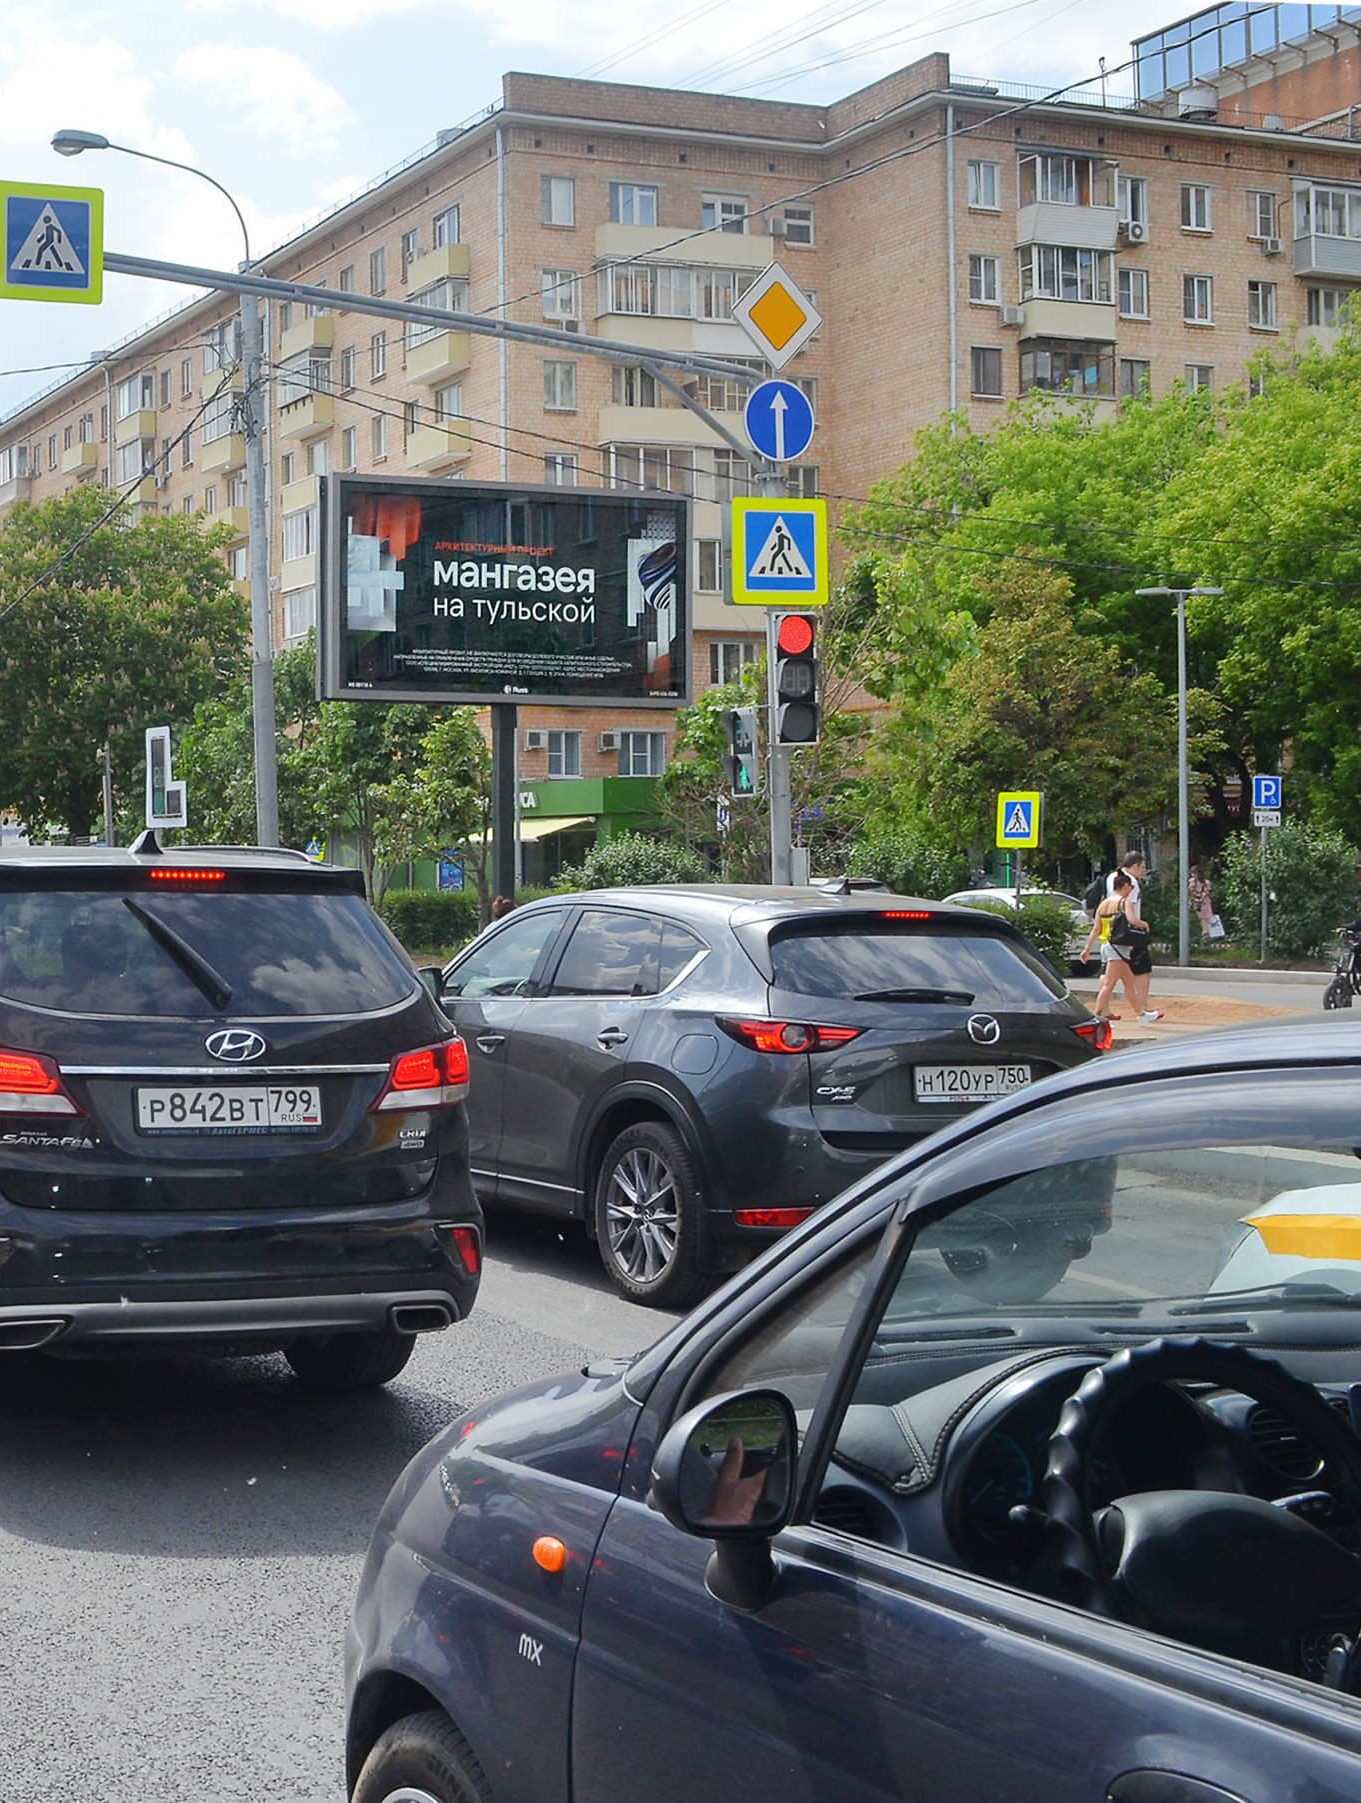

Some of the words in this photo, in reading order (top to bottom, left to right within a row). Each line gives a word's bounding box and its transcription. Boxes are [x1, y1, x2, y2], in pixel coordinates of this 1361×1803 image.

[434, 541, 516, 555] АРХИТЕКТУРНЫЙ
[517, 545, 554, 557] ПРОЕКТ
[434, 560, 595, 593] мангазея
[434, 598, 464, 617] на
[472, 597, 595, 625] тульской
[270, 1089, 313, 1113] 799
[281, 1114, 302, 1122] RUS
